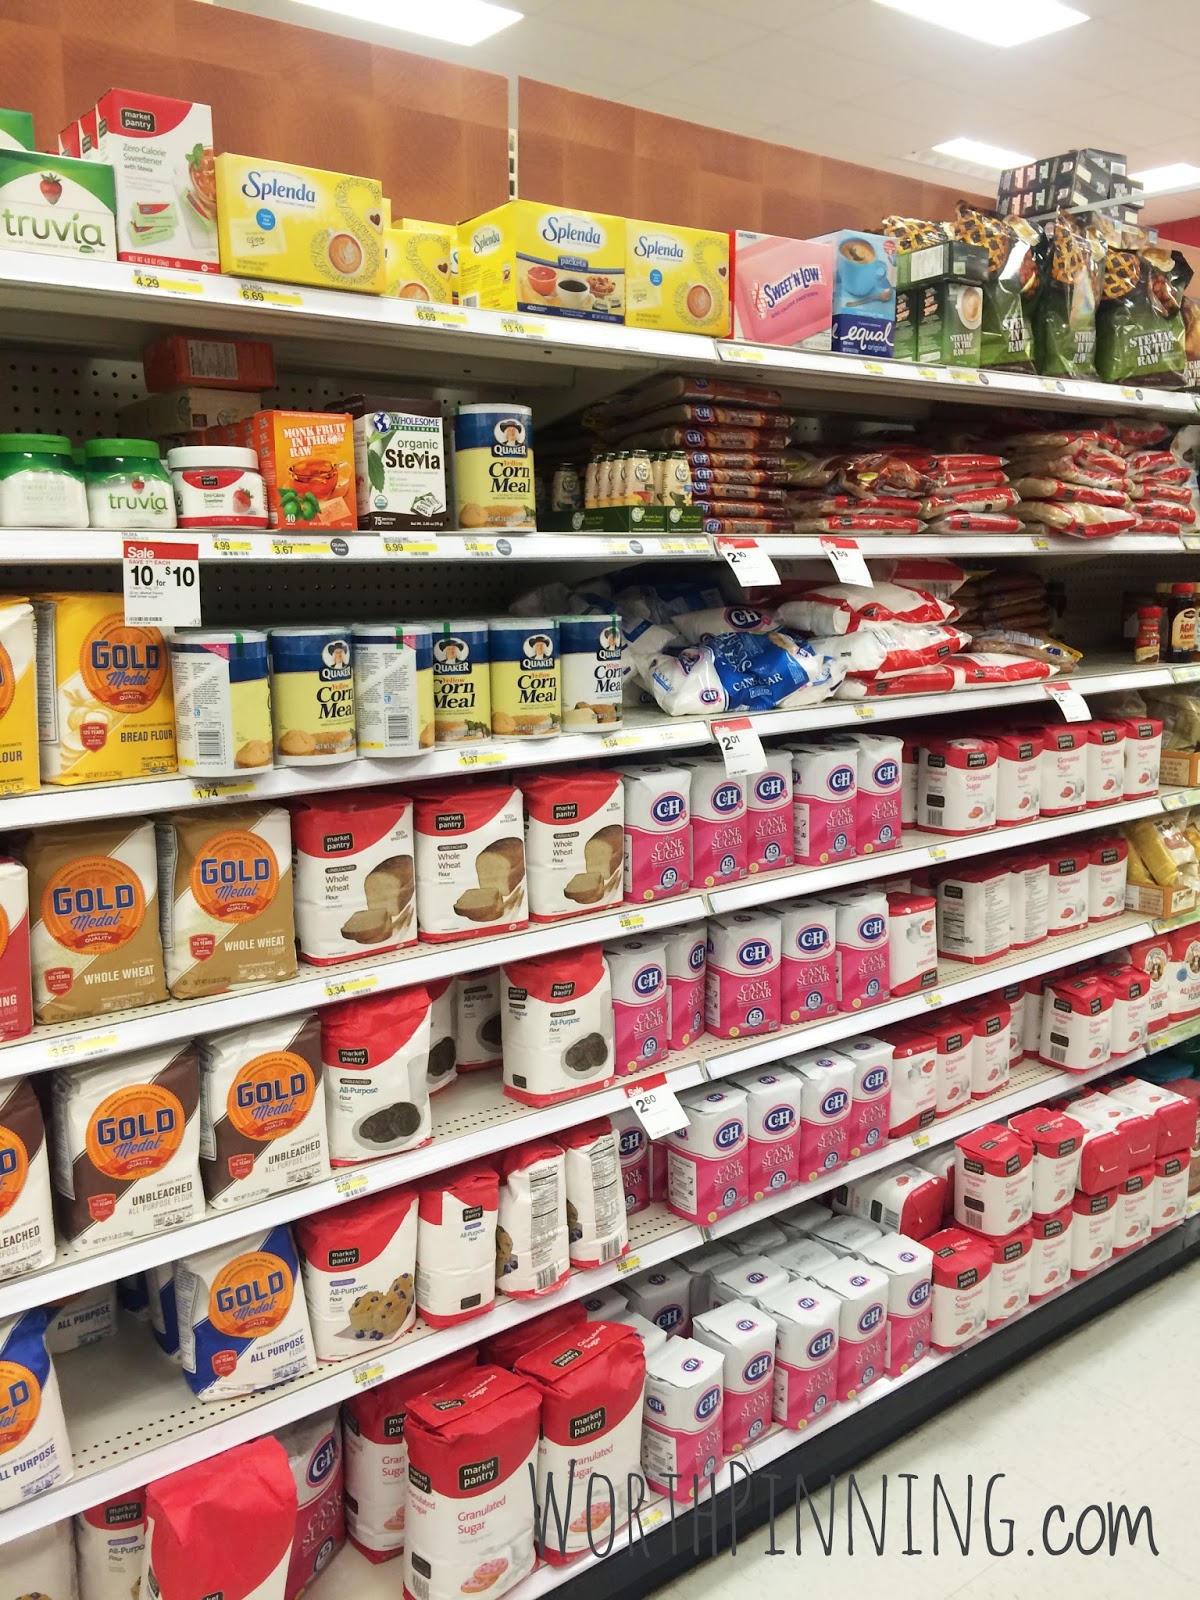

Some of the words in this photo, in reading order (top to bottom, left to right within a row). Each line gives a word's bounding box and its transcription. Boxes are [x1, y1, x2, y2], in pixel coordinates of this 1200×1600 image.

[124, 111, 151, 121] market
[125, 119, 152, 131] pantry
[242, 170, 316, 204] Splenda
[542, 216, 601, 246] Splenda
[473, 230, 500, 254] Splenda
[634, 235, 684, 259] Splenda
[136, 277, 160, 289] 4.29
[800, 266, 819, 289] LOW
[242, 291, 264, 301] 6.69
[417, 311, 436, 322] 6.69
[840, 322, 894, 350] equal
[867, 343, 887, 353] original
[1136, 352, 1160, 367] RAW
[391, 416, 440, 427] WHOLESOME
[283, 426, 315, 439] MONK
[315, 423, 347, 435] FRUIT
[291, 438, 304, 448] IN
[304, 435, 329, 446] THE
[397, 439, 439, 451] organic
[289, 446, 313, 458] RAW
[493, 444, 526, 456] QUAKER
[385, 449, 441, 470] Stevia
[488, 461, 530, 478] Corn
[490, 478, 531, 494] Meal
[285, 514, 296, 523] 40
[374, 516, 382, 526] 75
[127, 546, 155, 559] Sale
[213, 541, 230, 551] 4.99
[274, 546, 294, 555] 3.67
[385, 543, 404, 552] 6.99
[131, 565, 154, 586] 10
[155, 579, 166, 587] for
[730, 607, 762, 626] C&H
[91, 640, 160, 670] GOLD
[522, 657, 554, 669] QUAKER
[105, 670, 152, 688] Medal
[517, 673, 557, 691] Corn
[518, 687, 557, 705] Meal
[701, 690, 718, 701] C&H
[120, 729, 149, 743] BREAD
[150, 728, 174, 742] FLOUR
[462, 755, 478, 765] 1.37
[197, 788, 219, 800] 1.74
[759, 779, 783, 797] C&H
[656, 800, 682, 819] C&H
[438, 814, 462, 824] market
[438, 821, 463, 831] pantry
[758, 815, 786, 830] CANE
[755, 823, 789, 838] SUGAR
[327, 834, 351, 844] market
[327, 841, 352, 852] pantry
[655, 837, 684, 853] CANE
[437, 851, 461, 861] Whole
[650, 846, 685, 864] SUGAR
[201, 858, 271, 885] GOLD
[437, 860, 462, 870] Wheat
[325, 874, 350, 884] Whole
[215, 884, 261, 902] Medal
[325, 883, 350, 893] Wheat
[53, 884, 135, 915] GOLD
[226, 904, 251, 913] QUALITY
[70, 911, 123, 932] Medal
[84, 933, 113, 943] QUALITY
[224, 937, 255, 952] WHOLE
[257, 935, 286, 949] WHEAT
[800, 931, 826, 949] C&H
[740, 943, 768, 964] C&H
[84, 970, 120, 986] WHOLE
[122, 964, 155, 981] WHEAT
[796, 974, 831, 989] SUGAR
[799, 966, 829, 982] CANE
[327, 985, 346, 997] 3.34
[553, 982, 575, 991] market
[553, 989, 575, 998] pantry
[740, 980, 770, 995] CANE
[736, 988, 773, 1003] SUGAR
[339, 1049, 366, 1059] market
[341, 1055, 367, 1065] pantry
[236, 1073, 307, 1109] GOLD
[339, 1086, 379, 1096] All-Purpose
[627, 1087, 644, 1098] Sale
[251, 1101, 296, 1123] Medal
[97, 1107, 175, 1146] GOLD
[767, 1111, 793, 1129] C&H
[113, 1138, 163, 1161] Medal
[268, 1140, 321, 1165] UNBLEACHED
[766, 1144, 793, 1160] CANE
[762, 1151, 795, 1168] SUGAR
[132, 1180, 193, 1207] UNBLEACHED
[336, 1181, 350, 1194] 2.09
[128, 1207, 140, 1216] ALL
[143, 1198, 175, 1213] PURPOSE
[332, 1249, 356, 1259] market
[332, 1255, 358, 1266] pantry
[216, 1270, 285, 1314] GOLD
[329, 1283, 369, 1297] All-Purpose
[232, 1300, 278, 1322] Medal
[250, 1351, 267, 1364] ALL
[266, 1334, 306, 1360] PURPOSE
[811, 1334, 836, 1356] C&H
[699, 1390, 721, 1415] C&H
[574, 1410, 602, 1427] market
[574, 1418, 603, 1438] pantry
[9, 1444, 57, 1474] PURPOSE
[463, 1459, 495, 1476] market
[463, 1469, 497, 1488] pantry
[108, 1503, 138, 1515] market
[108, 1510, 139, 1523] pantry
[457, 1495, 507, 1523] Granulated
[457, 1520, 486, 1535] Sugar
